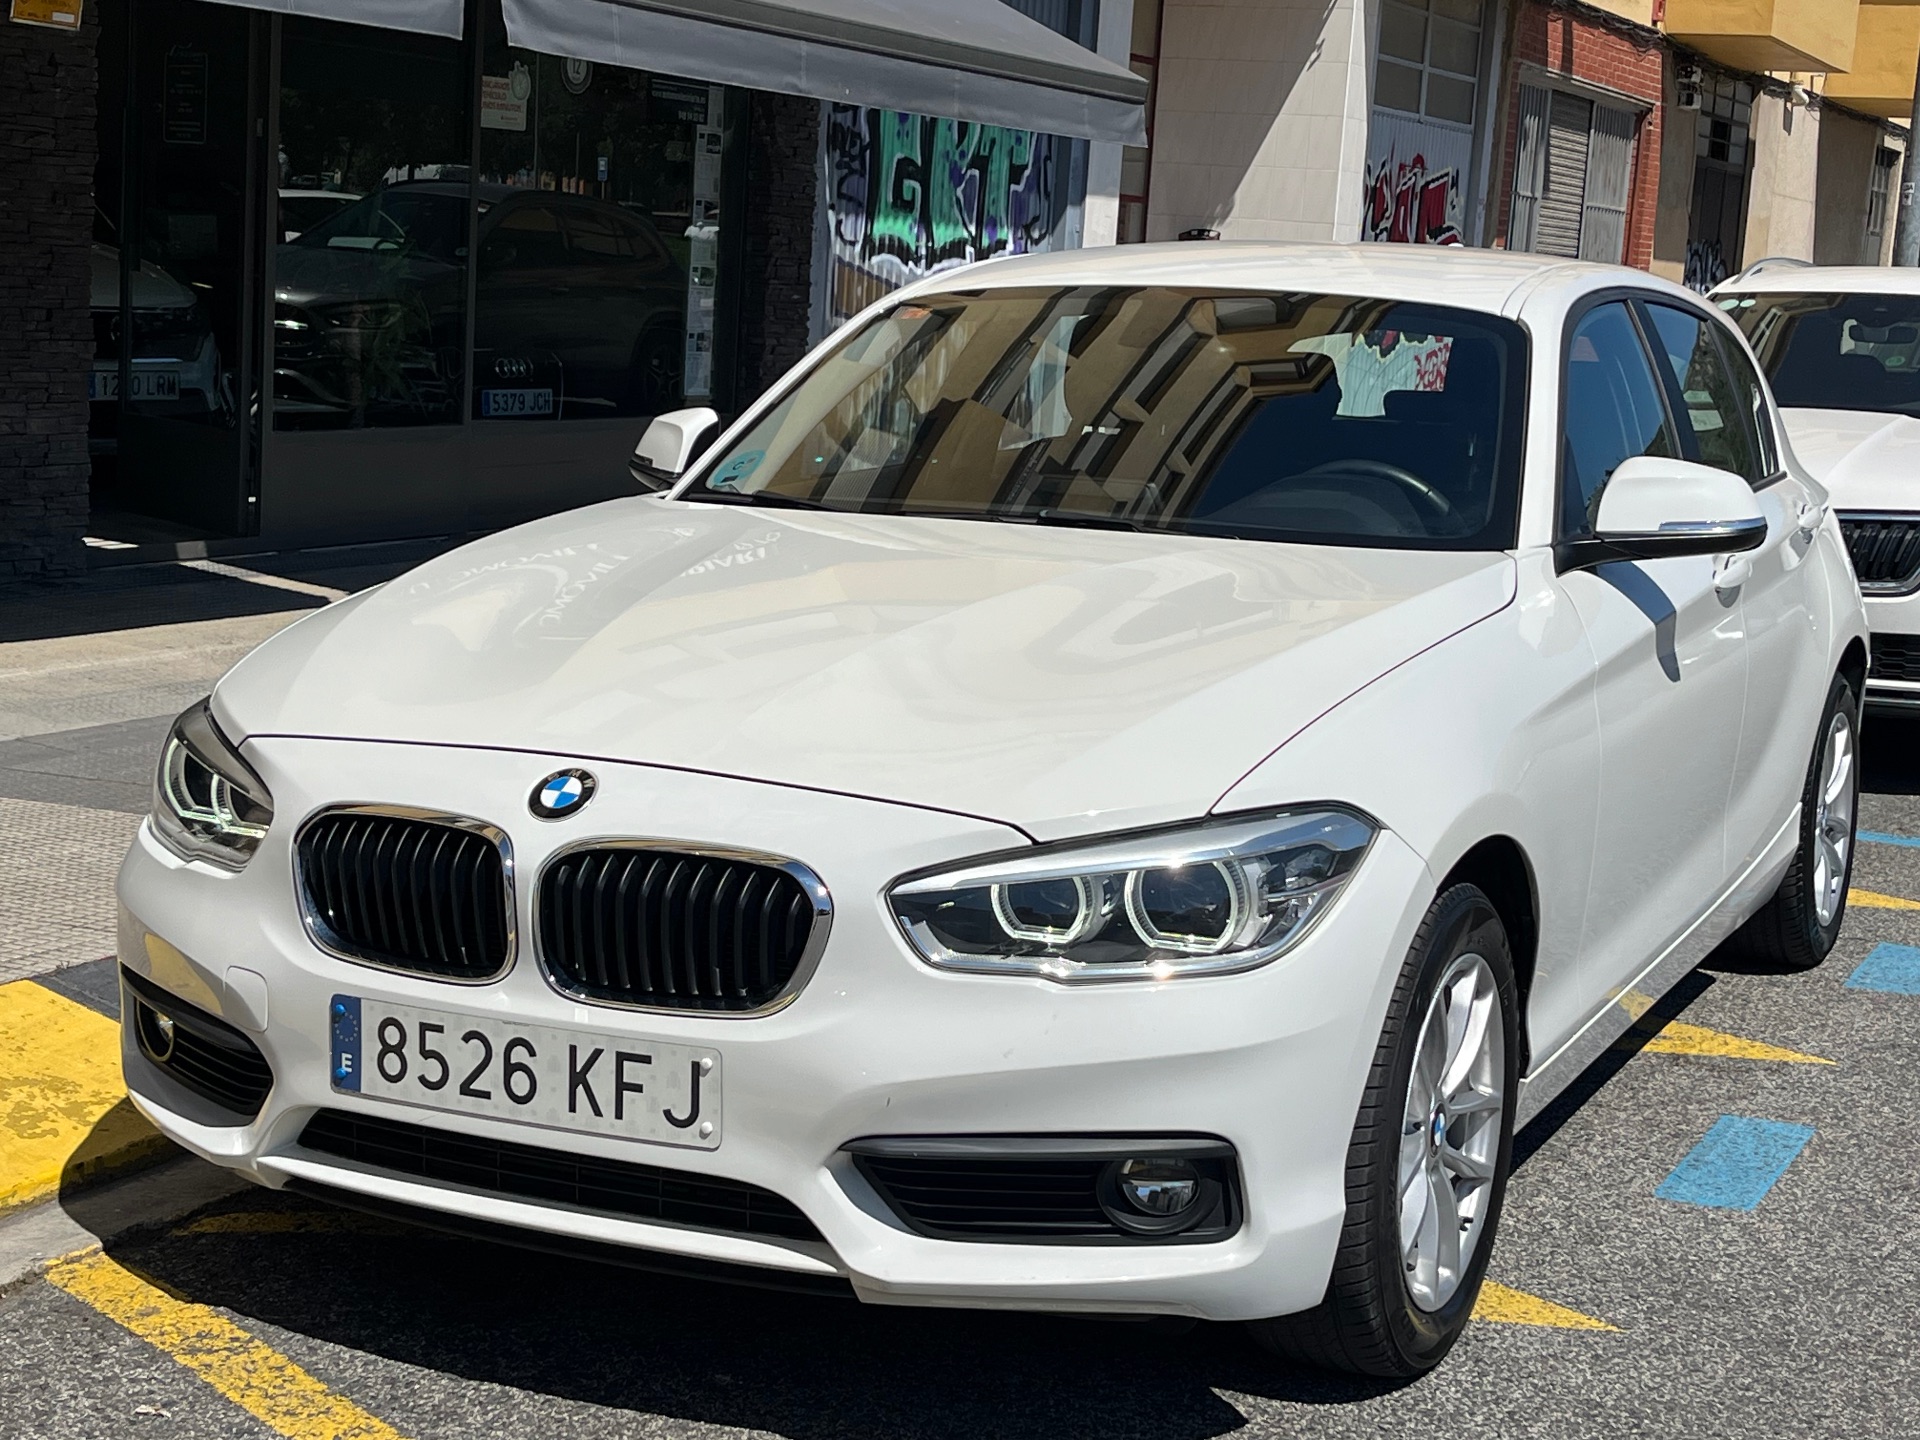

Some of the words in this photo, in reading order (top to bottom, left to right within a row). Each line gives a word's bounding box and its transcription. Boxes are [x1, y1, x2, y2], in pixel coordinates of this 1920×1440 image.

[102, 374, 141, 396] 120
[492, 392, 526, 412] 5379
[530, 391, 551, 411] JCH
[546, 769, 596, 788] BMW
[340, 1053, 353, 1073] E
[376, 1016, 538, 1105] 8526
[567, 1043, 702, 1129] KFJ
